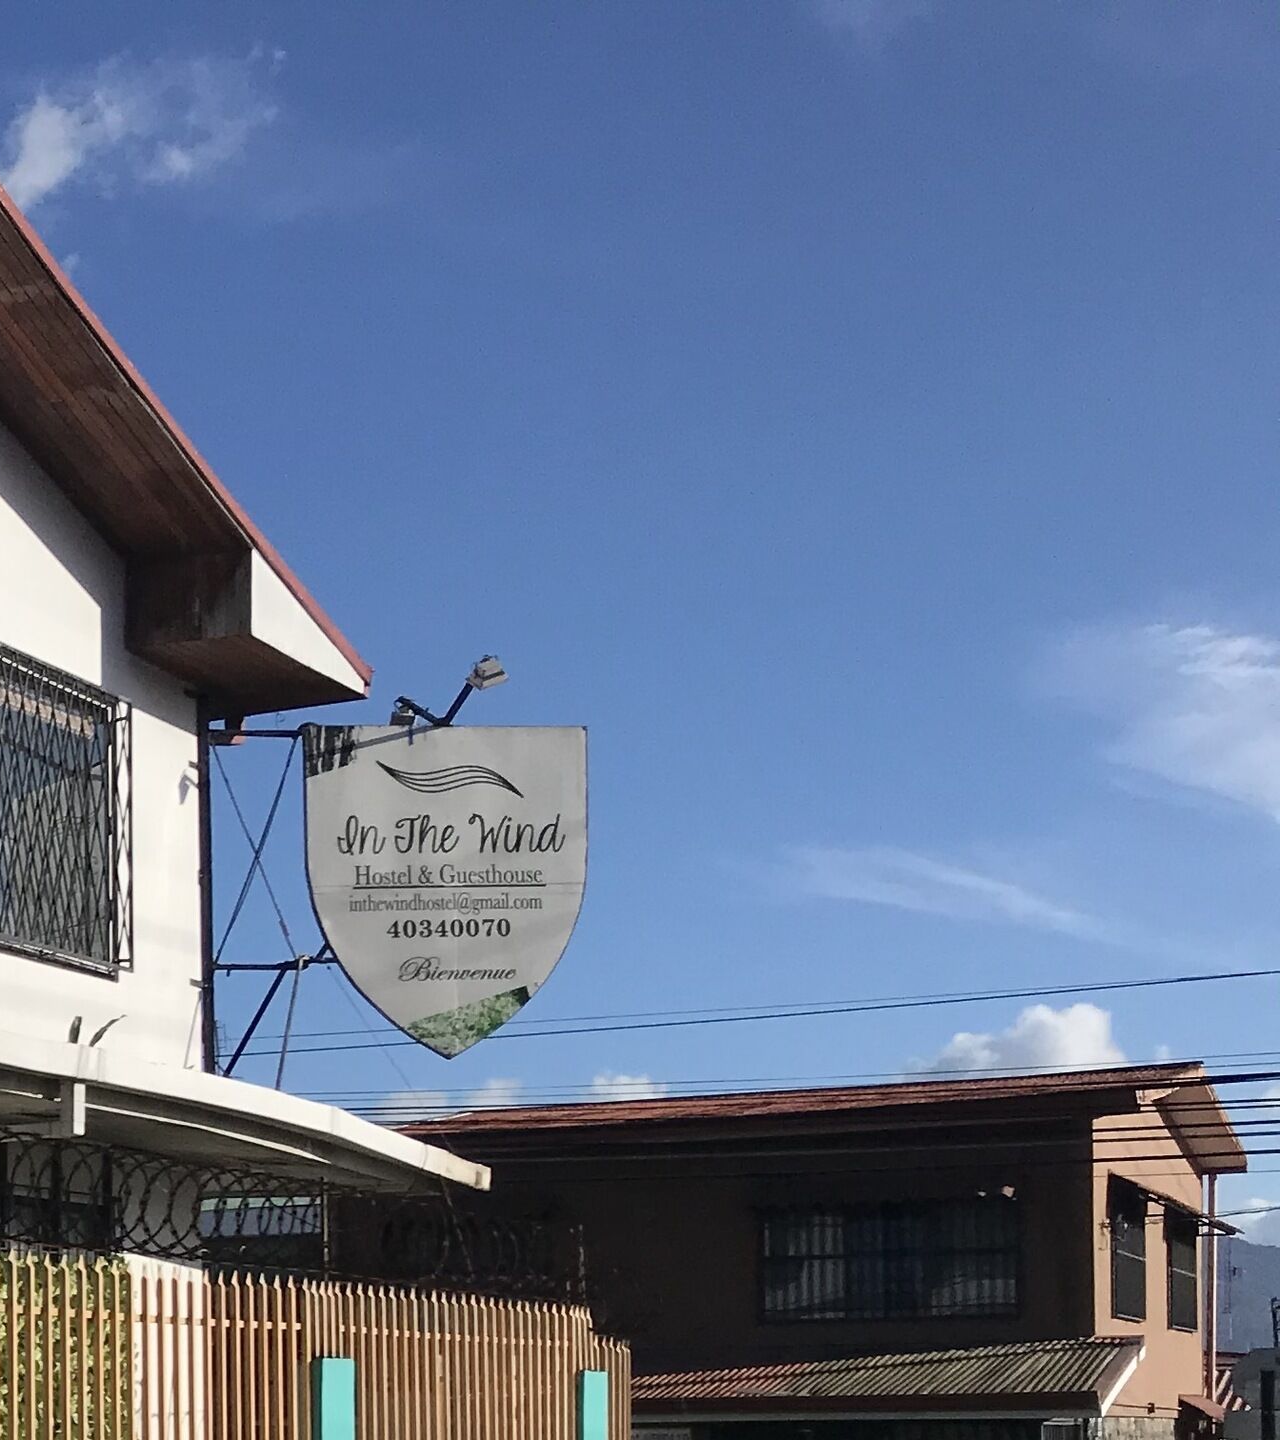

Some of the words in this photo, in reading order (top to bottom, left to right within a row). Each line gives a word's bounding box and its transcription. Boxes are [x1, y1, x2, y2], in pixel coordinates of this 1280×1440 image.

[336, 814, 387, 856] In
[394, 814, 460, 855] The
[468, 813, 566, 854] Wind
[353, 865, 412, 886] Hostel
[418, 865, 434, 885] &
[439, 864, 543, 885] Guesthouse
[349, 892, 543, 914] inthewindhostel@gmail.com
[386, 919, 511, 939] 40340070
[398, 956, 517, 982] Bienvenue
